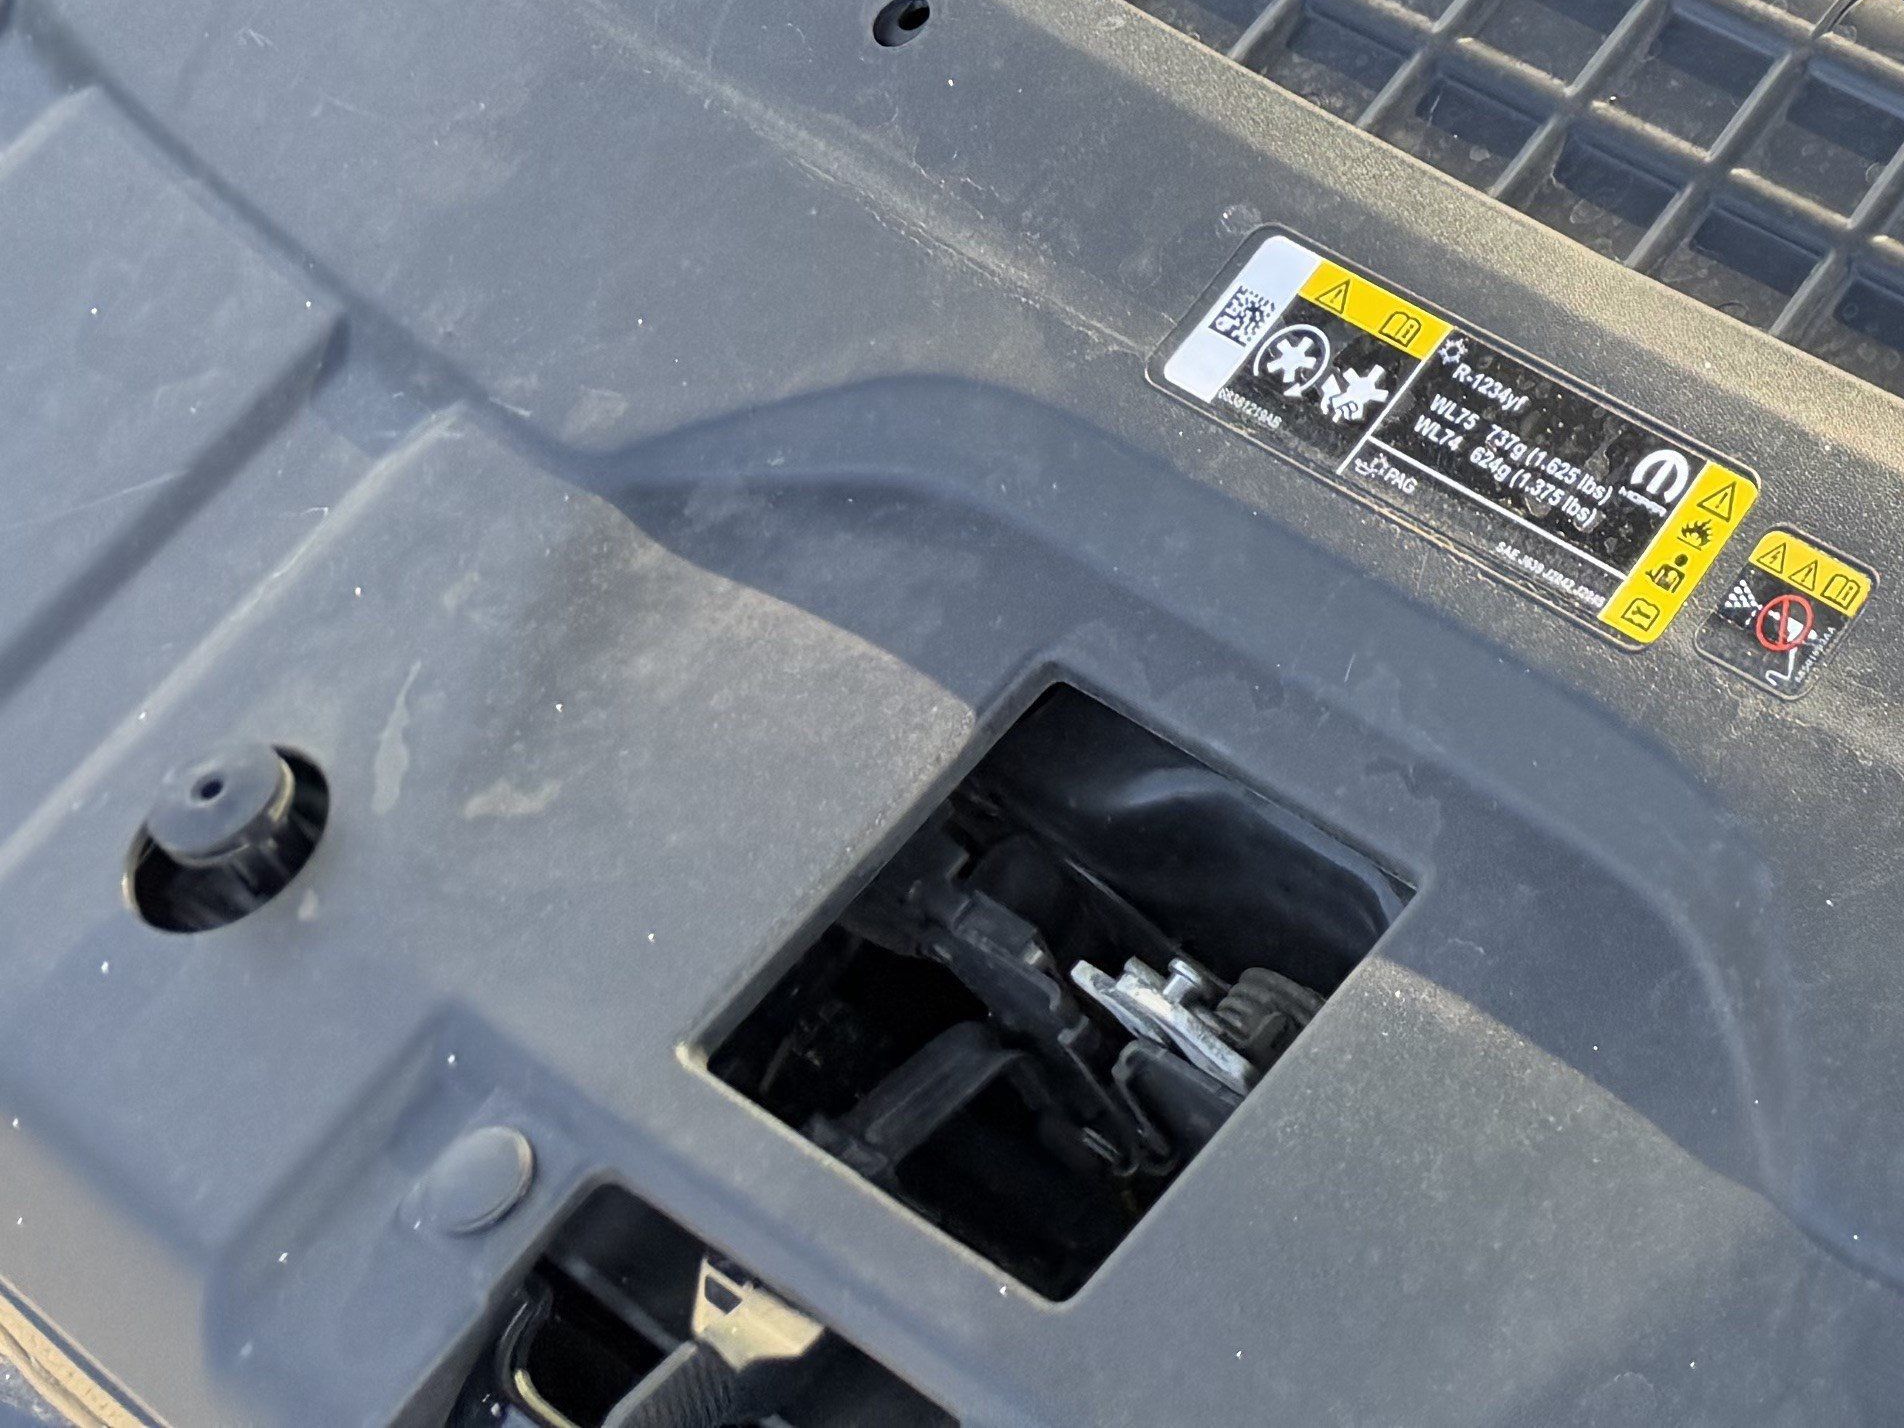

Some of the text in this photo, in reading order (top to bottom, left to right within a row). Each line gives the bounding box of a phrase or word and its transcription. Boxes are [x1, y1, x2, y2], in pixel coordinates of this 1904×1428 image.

[1453, 365, 1526, 413] R-1234yf
[1413, 415, 1598, 528] WL74 624g (1.375 lbs)
[1429, 394, 1614, 506] WL75 737g (1.625 lbs)
[1385, 466, 1417, 495] PAG
[1495, 541, 1518, 562] SAE
